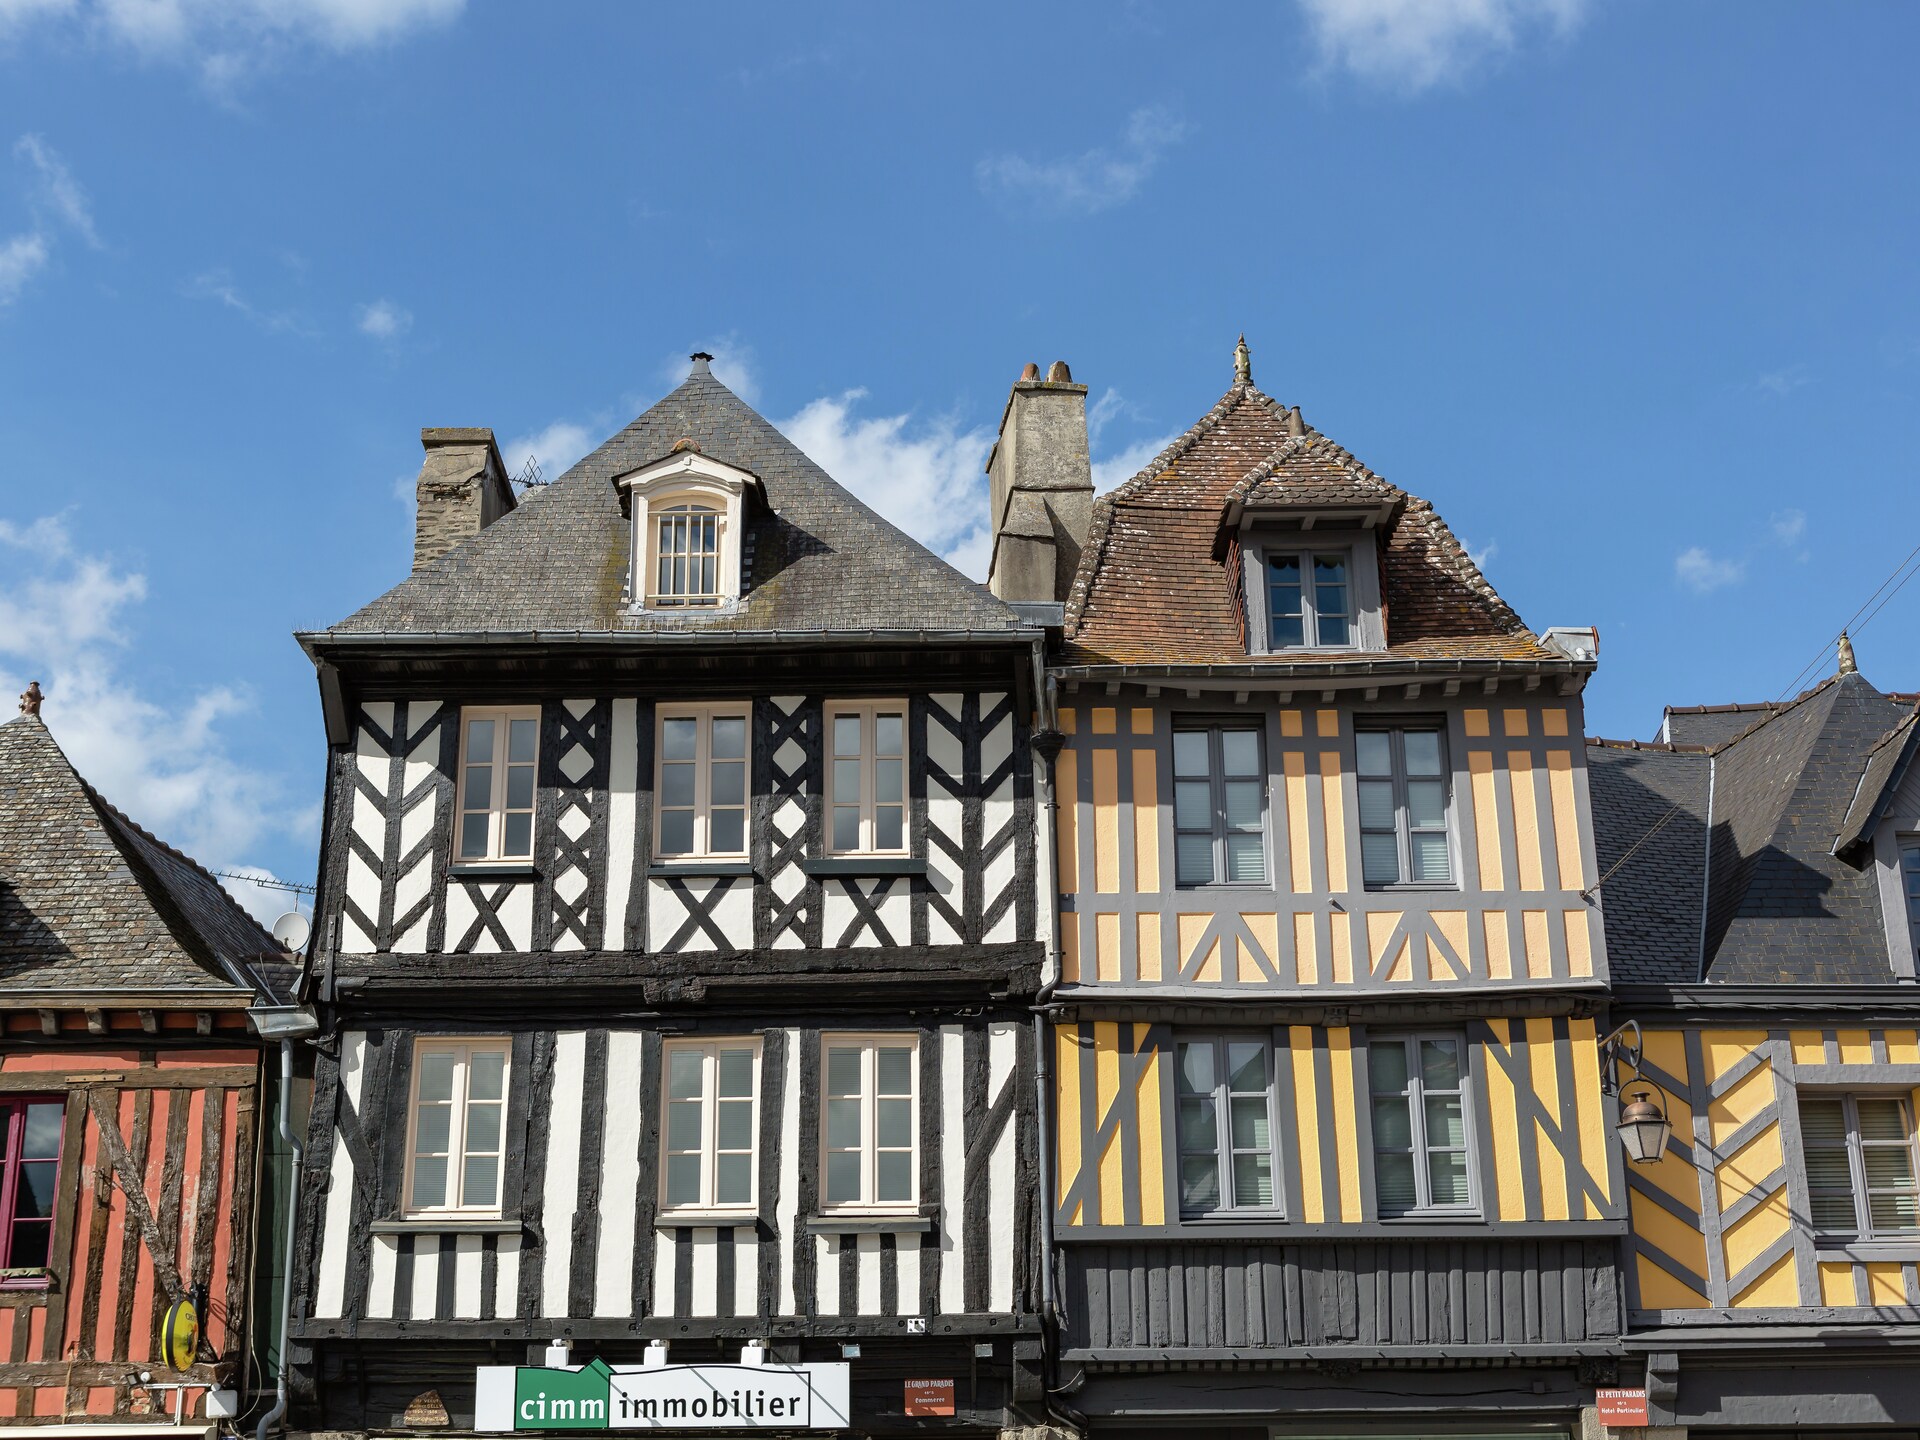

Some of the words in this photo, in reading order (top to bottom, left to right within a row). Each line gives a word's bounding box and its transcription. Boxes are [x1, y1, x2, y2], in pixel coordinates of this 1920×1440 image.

[905, 1380, 911, 1388] LE
[911, 1380, 929, 1388] GRAND
[930, 1379, 954, 1388] PARADIS
[1605, 1390, 1621, 1398] PETIT
[1621, 1390, 1646, 1398] PARADIS
[520, 1391, 605, 1420] cimm
[619, 1390, 801, 1419] immobilier
